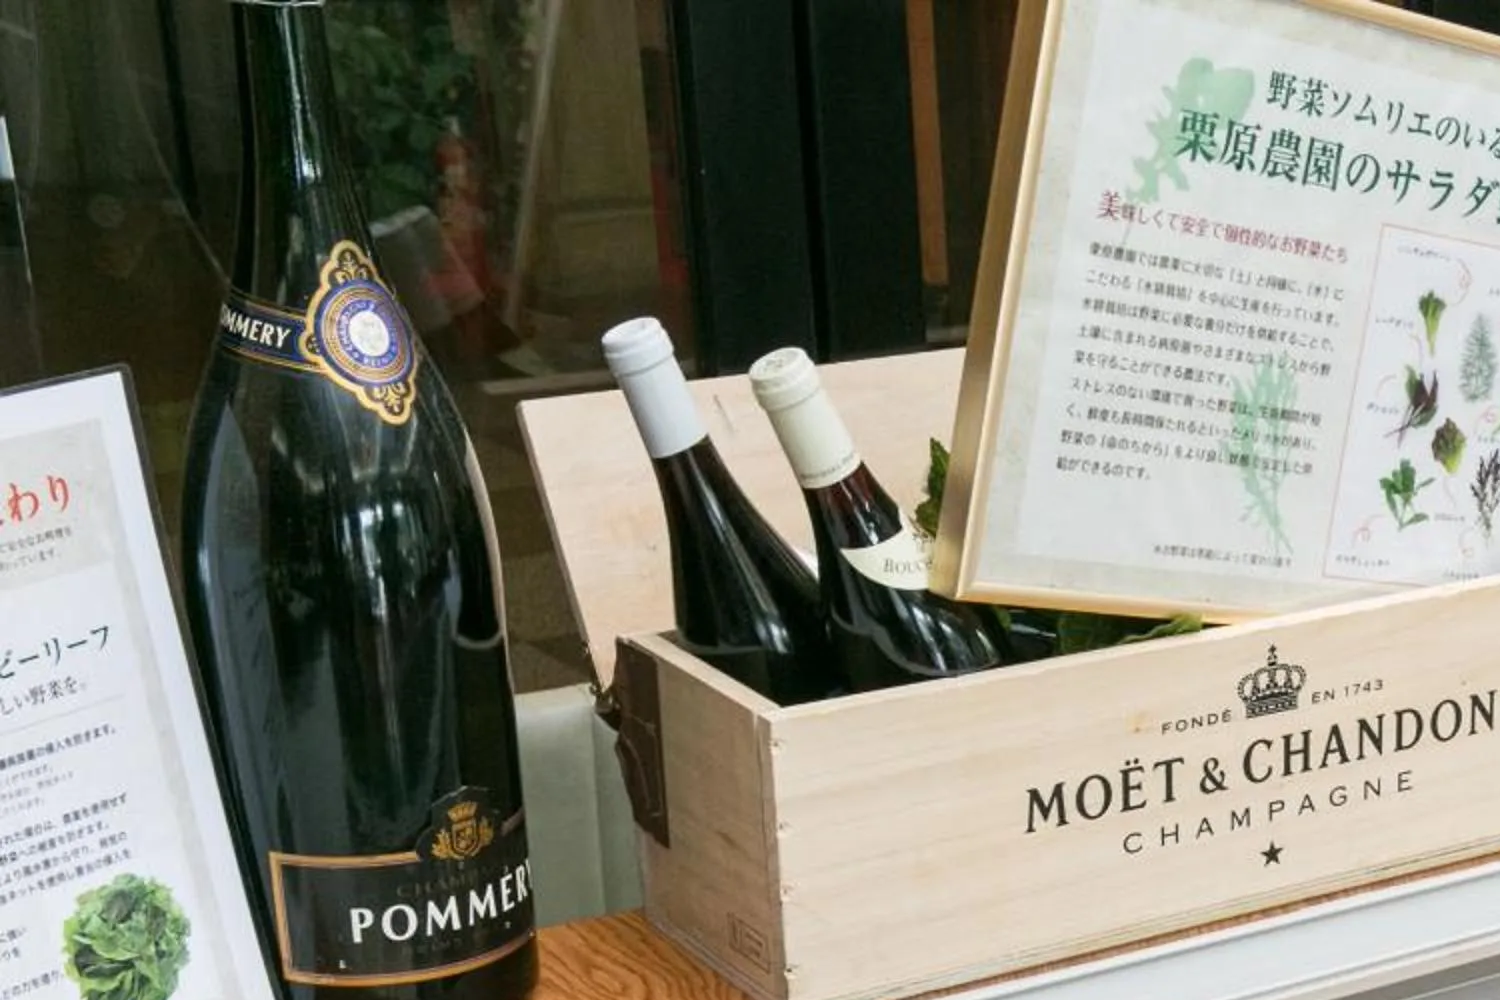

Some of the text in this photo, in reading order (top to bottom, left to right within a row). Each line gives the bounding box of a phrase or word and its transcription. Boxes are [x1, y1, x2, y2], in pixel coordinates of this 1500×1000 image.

[1097, 191, 1349, 265] 美味しくて安全で個性的なお野菜たち
[0, 474, 70, 526] わり
[1311, 689, 1336, 705] EN
[1344, 679, 1385, 698] 1743
[1024, 689, 1500, 834] MOËT & CHANDON
[1121, 769, 1414, 855] CHAMPAGNE
